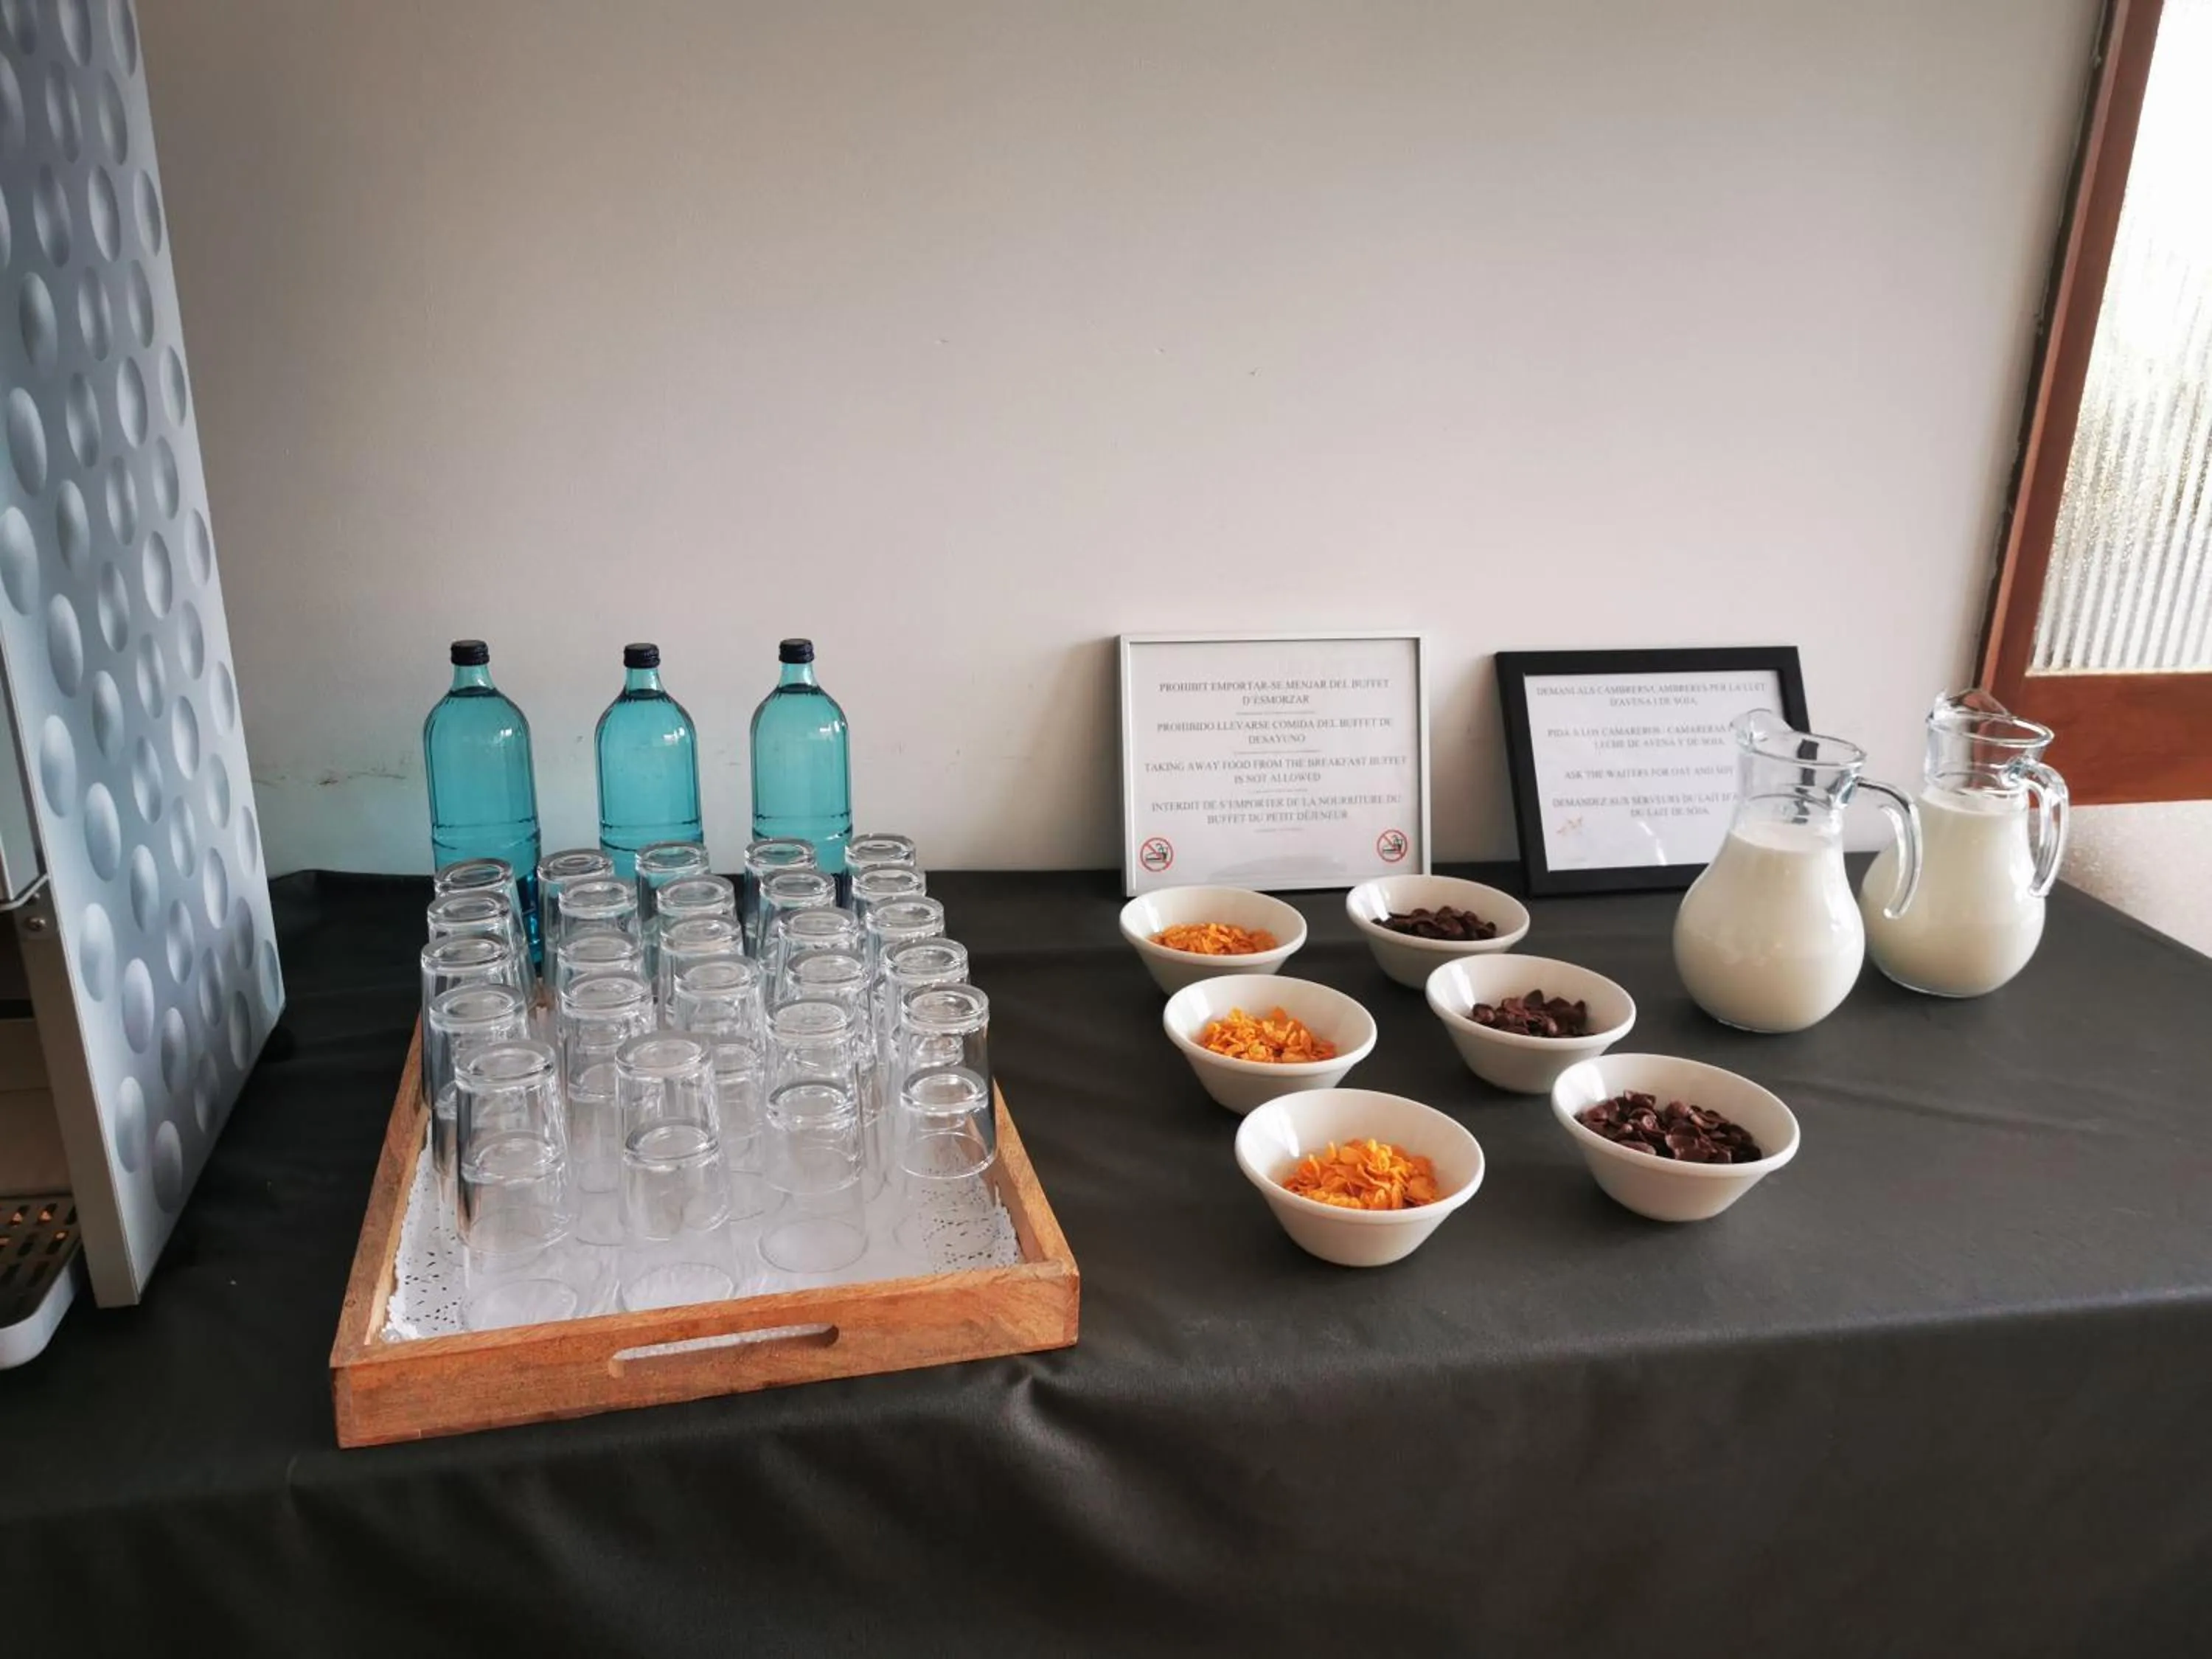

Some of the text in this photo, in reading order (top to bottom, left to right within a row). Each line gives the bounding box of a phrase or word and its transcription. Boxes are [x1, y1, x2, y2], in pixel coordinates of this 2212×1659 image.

[1160, 683, 1207, 692] PROHIBIT
[1286, 680, 1326, 689] MENJAR
[1329, 679, 1346, 689] DEL
[1352, 678, 1389, 688] BUFFET
[1157, 718, 1391, 731] PROHIBIDO LLEVARSE COMIDA DEL BUFFET DE
[1248, 734, 1306, 744] DESAYUNO
[1144, 756, 1405, 772] TAKING AWAY FOOD FROM THE BREAKFAST BUFFET
[1234, 773, 1321, 784] IS NOT ALLOWED
[1565, 771, 1582, 779] ASK
[1585, 769, 1603, 779] THE
[1152, 801, 1200, 812] INTERDIT
[1203, 801, 1215, 810] DE
[1287, 797, 1298, 807] DE
[1302, 797, 1316, 806] LA
[1386, 795, 1400, 803] DU
[1207, 814, 1246, 824] BUFFET
[1248, 813, 1262, 823] DU
[1266, 812, 1293, 822] PETIT
